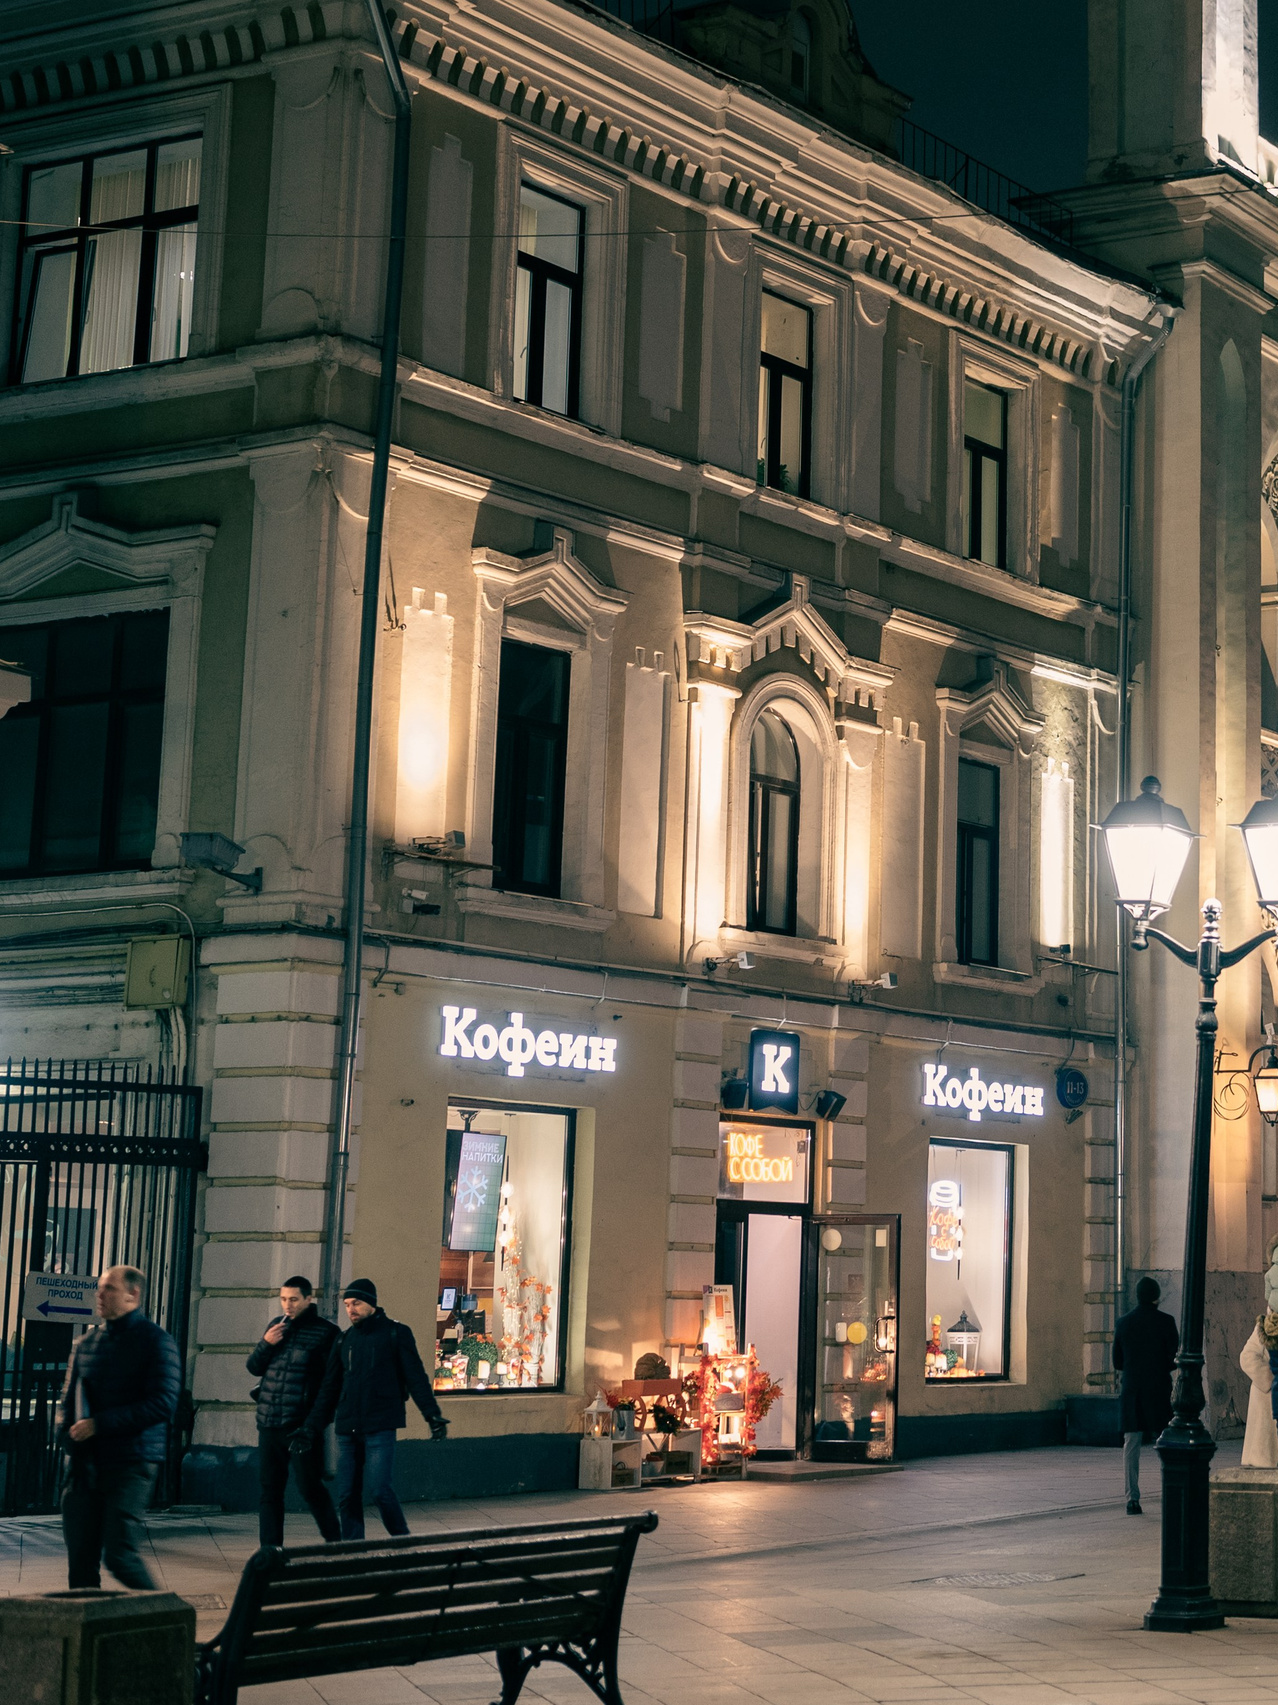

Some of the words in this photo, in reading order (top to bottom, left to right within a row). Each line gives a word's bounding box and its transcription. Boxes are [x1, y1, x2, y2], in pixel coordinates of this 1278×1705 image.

[440, 1005, 617, 1077] Кофеин
[761, 1044, 792, 1094] К
[923, 1063, 1044, 1122] Кофеин
[462, 1151, 503, 1164] НАПИТКИ
[463, 1140, 500, 1154] ЗИМНИЕ
[728, 1132, 764, 1158] КОФЕ
[741, 1156, 793, 1182] СОБОЙ
[36, 1276, 99, 1290] ПЕШЕХОДНЫЙ
[47, 1288, 84, 1301] ПРОХОД
